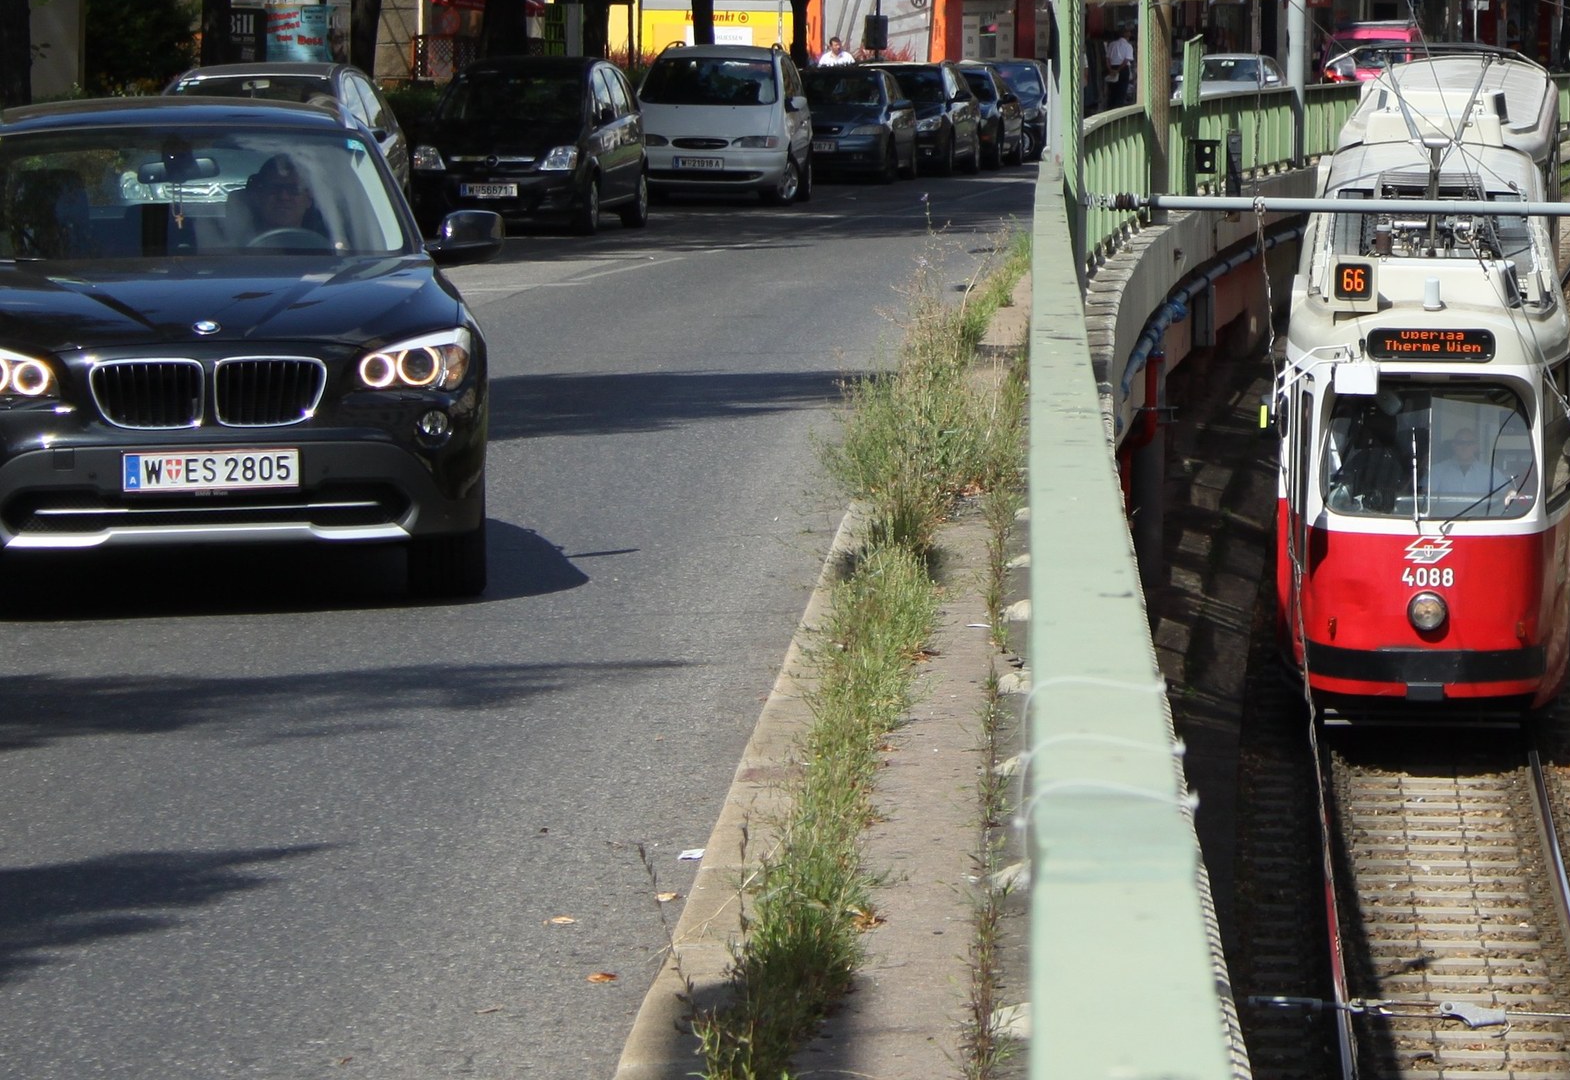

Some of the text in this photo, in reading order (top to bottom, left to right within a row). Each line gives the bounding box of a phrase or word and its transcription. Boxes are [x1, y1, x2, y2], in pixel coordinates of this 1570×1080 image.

[1342, 268, 1365, 292] 66
[1384, 339, 1482, 353] Therme Wien
[144, 455, 290, 485] W ES 2805
[129, 476, 137, 485] A
[1401, 567, 1454, 587] 4088
